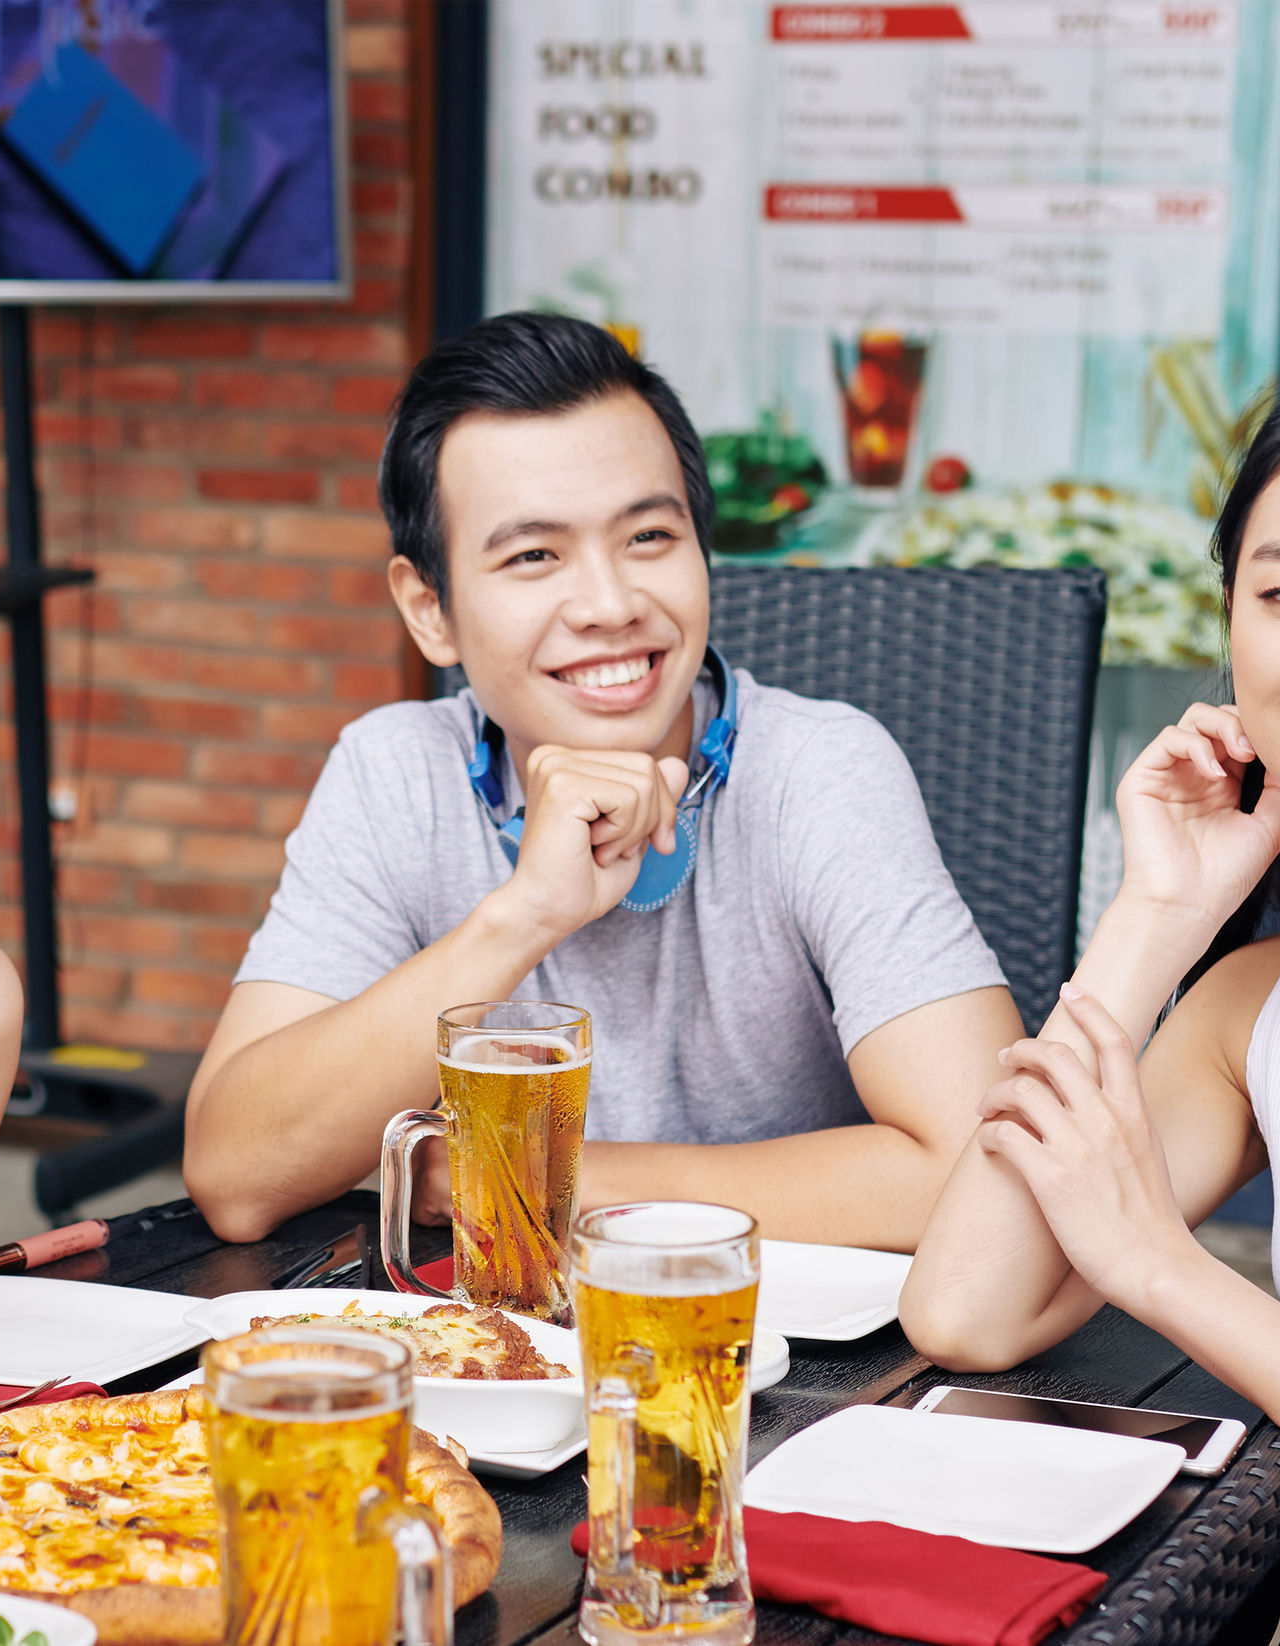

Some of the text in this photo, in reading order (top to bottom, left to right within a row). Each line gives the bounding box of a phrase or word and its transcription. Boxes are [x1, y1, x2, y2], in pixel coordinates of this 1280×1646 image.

[538, 41, 711, 80] SPECIAL
[536, 104, 658, 143] FOOD
[534, 163, 702, 206] COMBO
